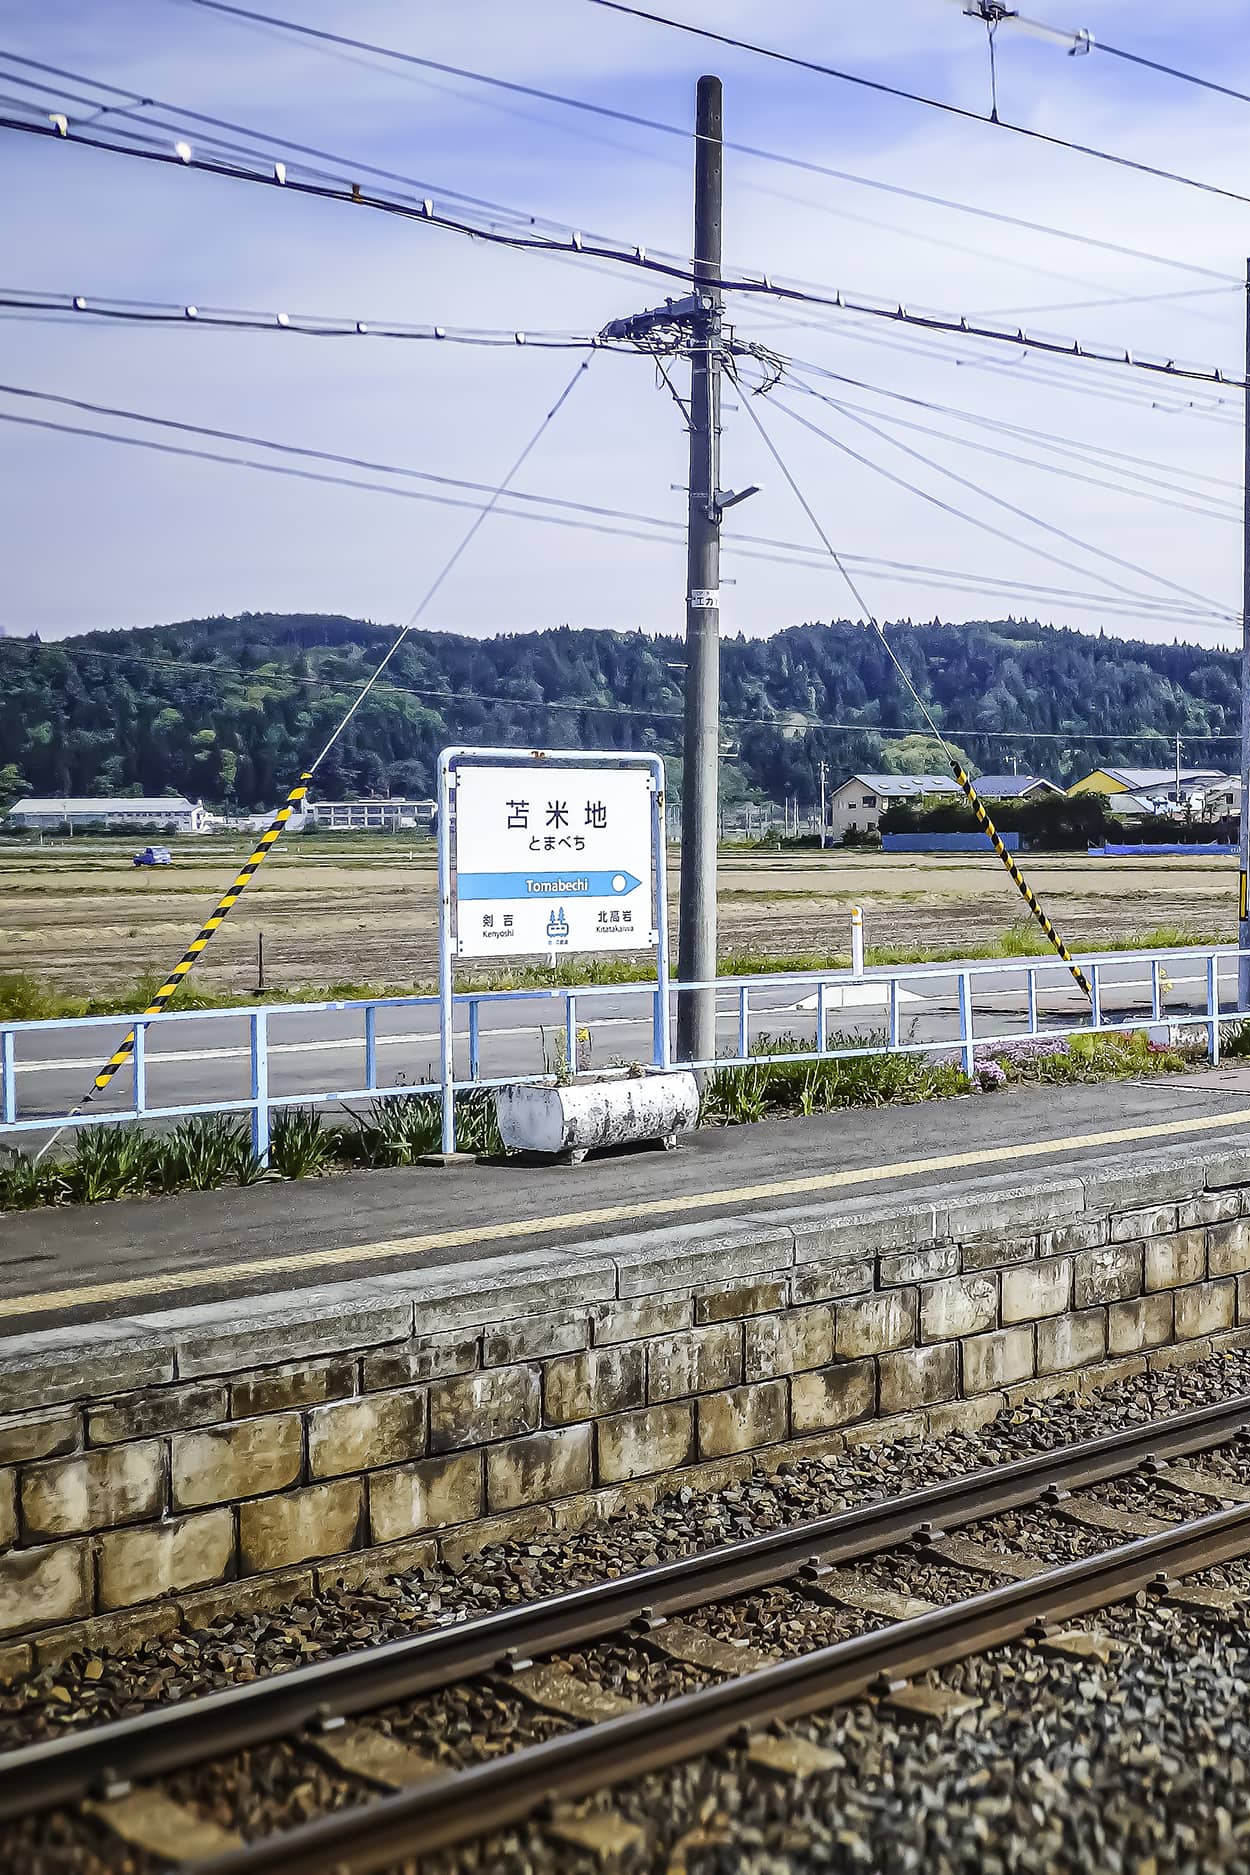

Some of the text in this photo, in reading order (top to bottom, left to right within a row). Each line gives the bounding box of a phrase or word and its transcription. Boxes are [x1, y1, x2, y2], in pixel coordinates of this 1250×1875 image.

[505, 799, 608, 830] 苫米地
[528, 835, 586, 851] とまべち
[525, 878, 589, 893] Tomabechi
[597, 910, 632, 923] 北高岩
[482, 929, 515, 940] Kenyoshi
